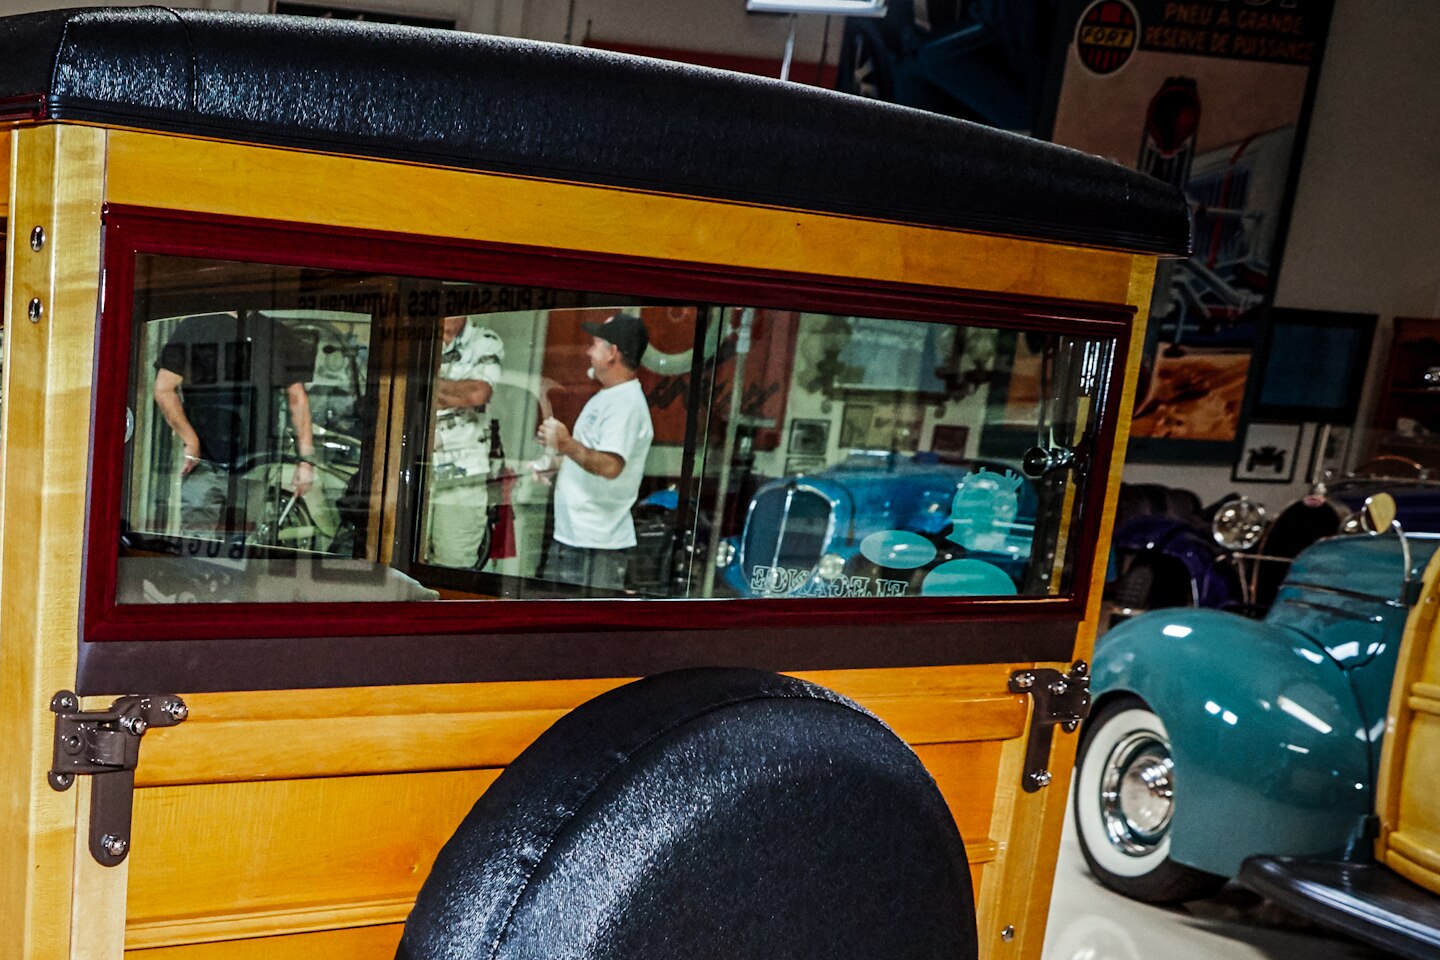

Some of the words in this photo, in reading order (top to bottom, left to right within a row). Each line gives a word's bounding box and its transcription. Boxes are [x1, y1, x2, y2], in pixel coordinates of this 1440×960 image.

[1163, 2, 1211, 26] PNEU
[1236, 11, 1305, 35] GRANDE
[1083, 27, 1129, 46] FORT
[1211, 31, 1231, 53] DE
[1232, 33, 1315, 60] PUISSANCE
